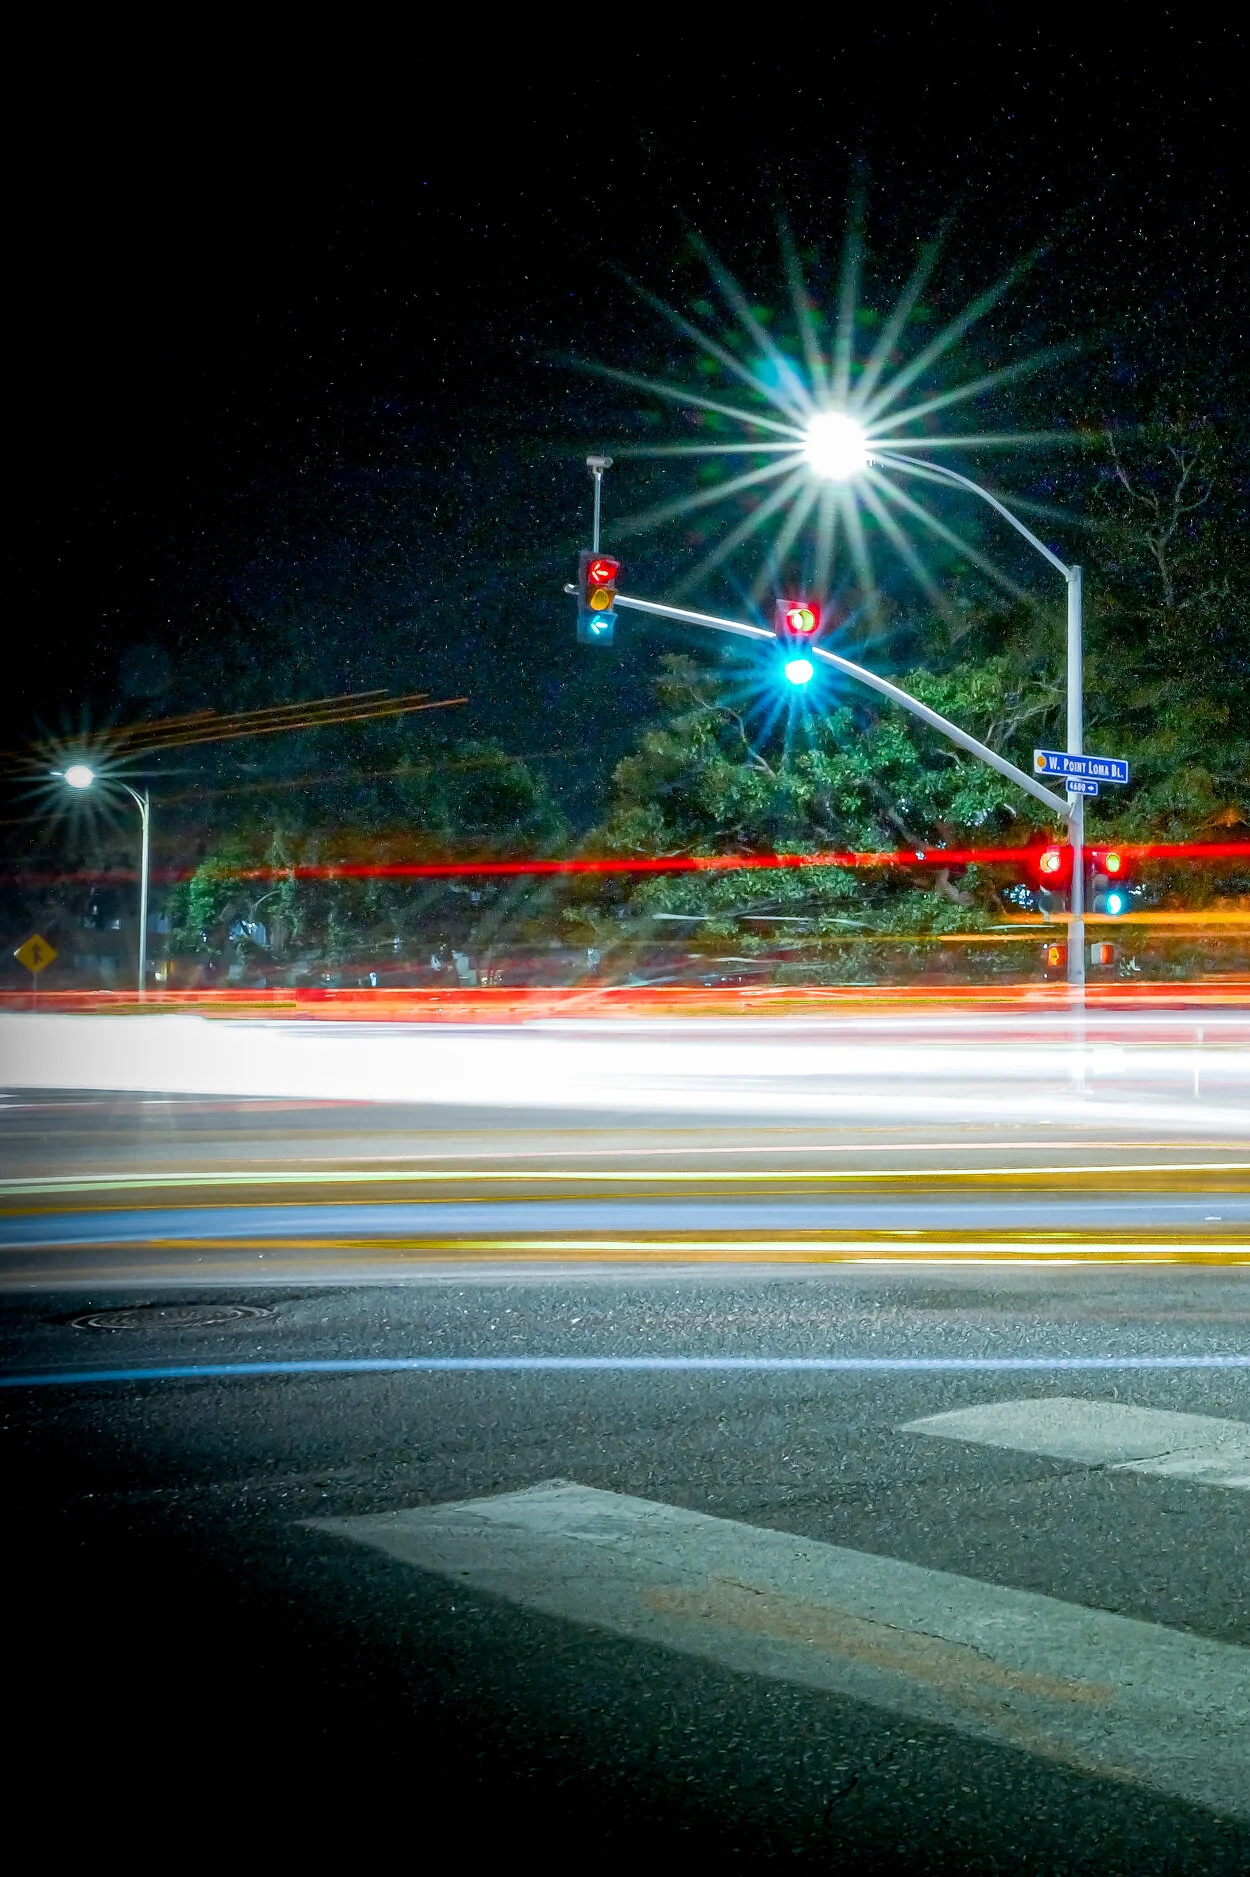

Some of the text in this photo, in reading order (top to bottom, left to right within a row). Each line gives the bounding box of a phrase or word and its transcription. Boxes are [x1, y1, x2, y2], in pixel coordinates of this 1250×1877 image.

[1049, 756, 1124, 779] W. POINT LOMA BL.
